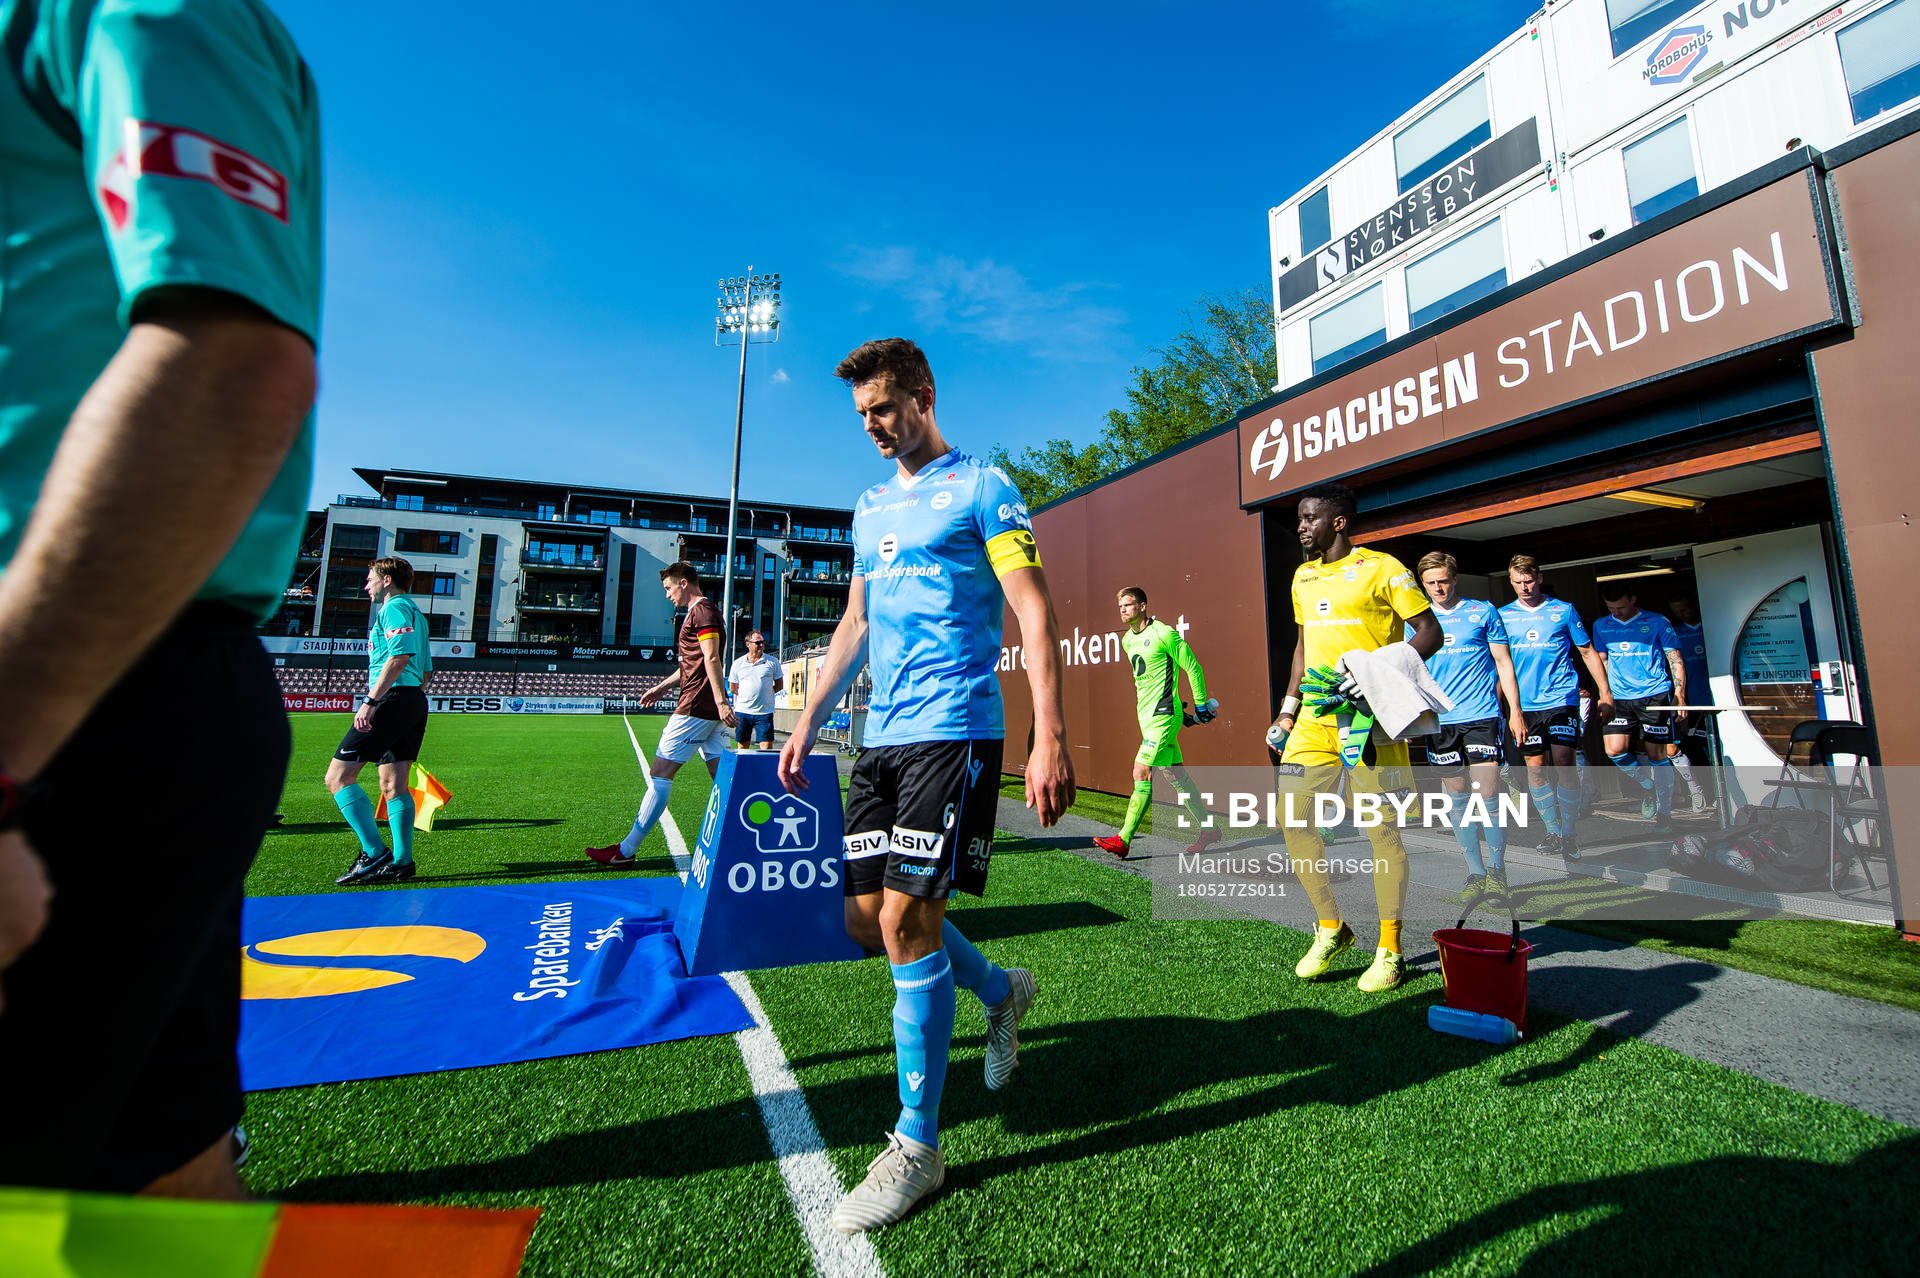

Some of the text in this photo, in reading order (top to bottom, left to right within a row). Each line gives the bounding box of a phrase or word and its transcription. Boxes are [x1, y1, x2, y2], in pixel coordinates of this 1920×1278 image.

[1722, 0, 1790, 38] NO
[1642, 30, 1714, 80] NORDBOHUS
[1350, 158, 1475, 249] SVENSSON
[1351, 181, 1477, 270] NØKLEBY
[1293, 231, 1789, 464] ISACHSEN STADION
[883, 562, 943, 581] Sparebank
[489, 647, 528, 655] MITSUBISHI
[1762, 669, 1808, 680] UNISPORT
[305, 697, 351, 709] Elektro
[431, 697, 501, 711] TESS
[525, 702, 548, 710] Stryken
[1567, 716, 1578, 728] 30
[943, 803, 955, 829] 6
[727, 857, 839, 893] OBOS
[512, 901, 581, 1002] Sparebanken
